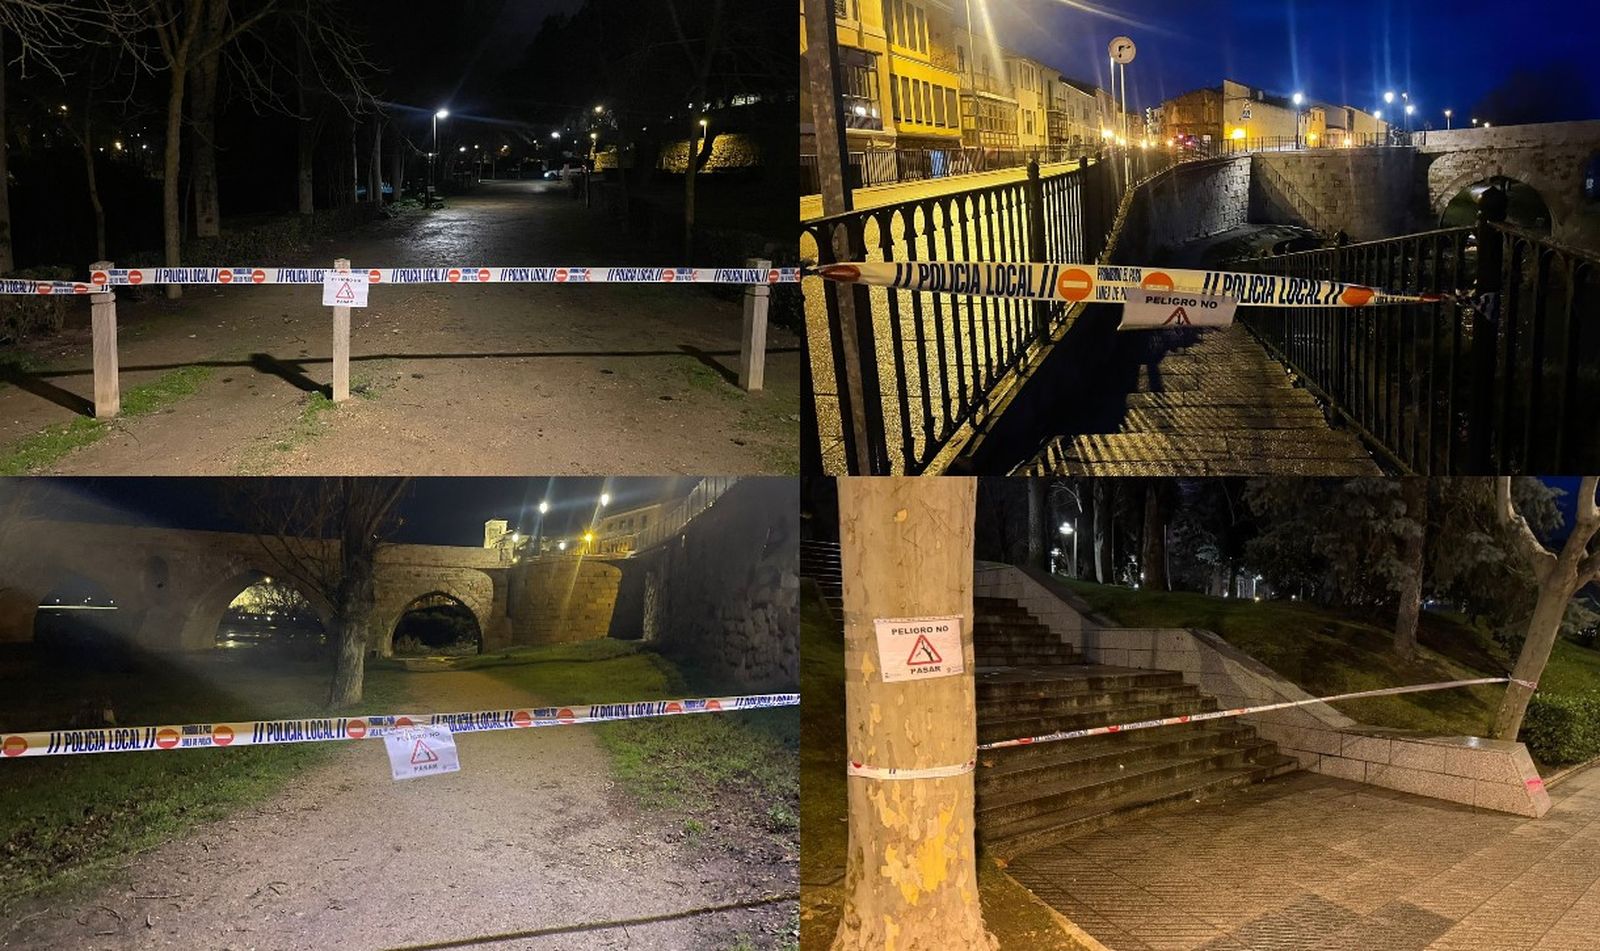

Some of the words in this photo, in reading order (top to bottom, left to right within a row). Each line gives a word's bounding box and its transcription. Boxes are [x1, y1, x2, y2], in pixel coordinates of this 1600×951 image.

[163, 269, 188, 283] POLICIA
[190, 269, 209, 283] LOCAL
[285, 269, 308, 283] POLICIA
[917, 263, 980, 295] POLICIA
[986, 265, 1036, 298] LOCAL
[1223, 273, 1276, 304] POLICIA
[1279, 277, 1321, 305] LOCAL
[1145, 296, 1197, 307] PELIGRO
[1200, 300, 1218, 309] NO
[891, 626, 934, 636] PELIGRO
[936, 625, 949, 633] NO
[910, 666, 941, 675] PASAR
[442, 712, 475, 732] POLICIA
[476, 711, 504, 730] LOCAL
[267, 720, 303, 742] POLICIA
[306, 719, 335, 740] LOCAL
[64, 728, 106, 753] POLICIA
[108, 728, 141, 750] LOCAL
